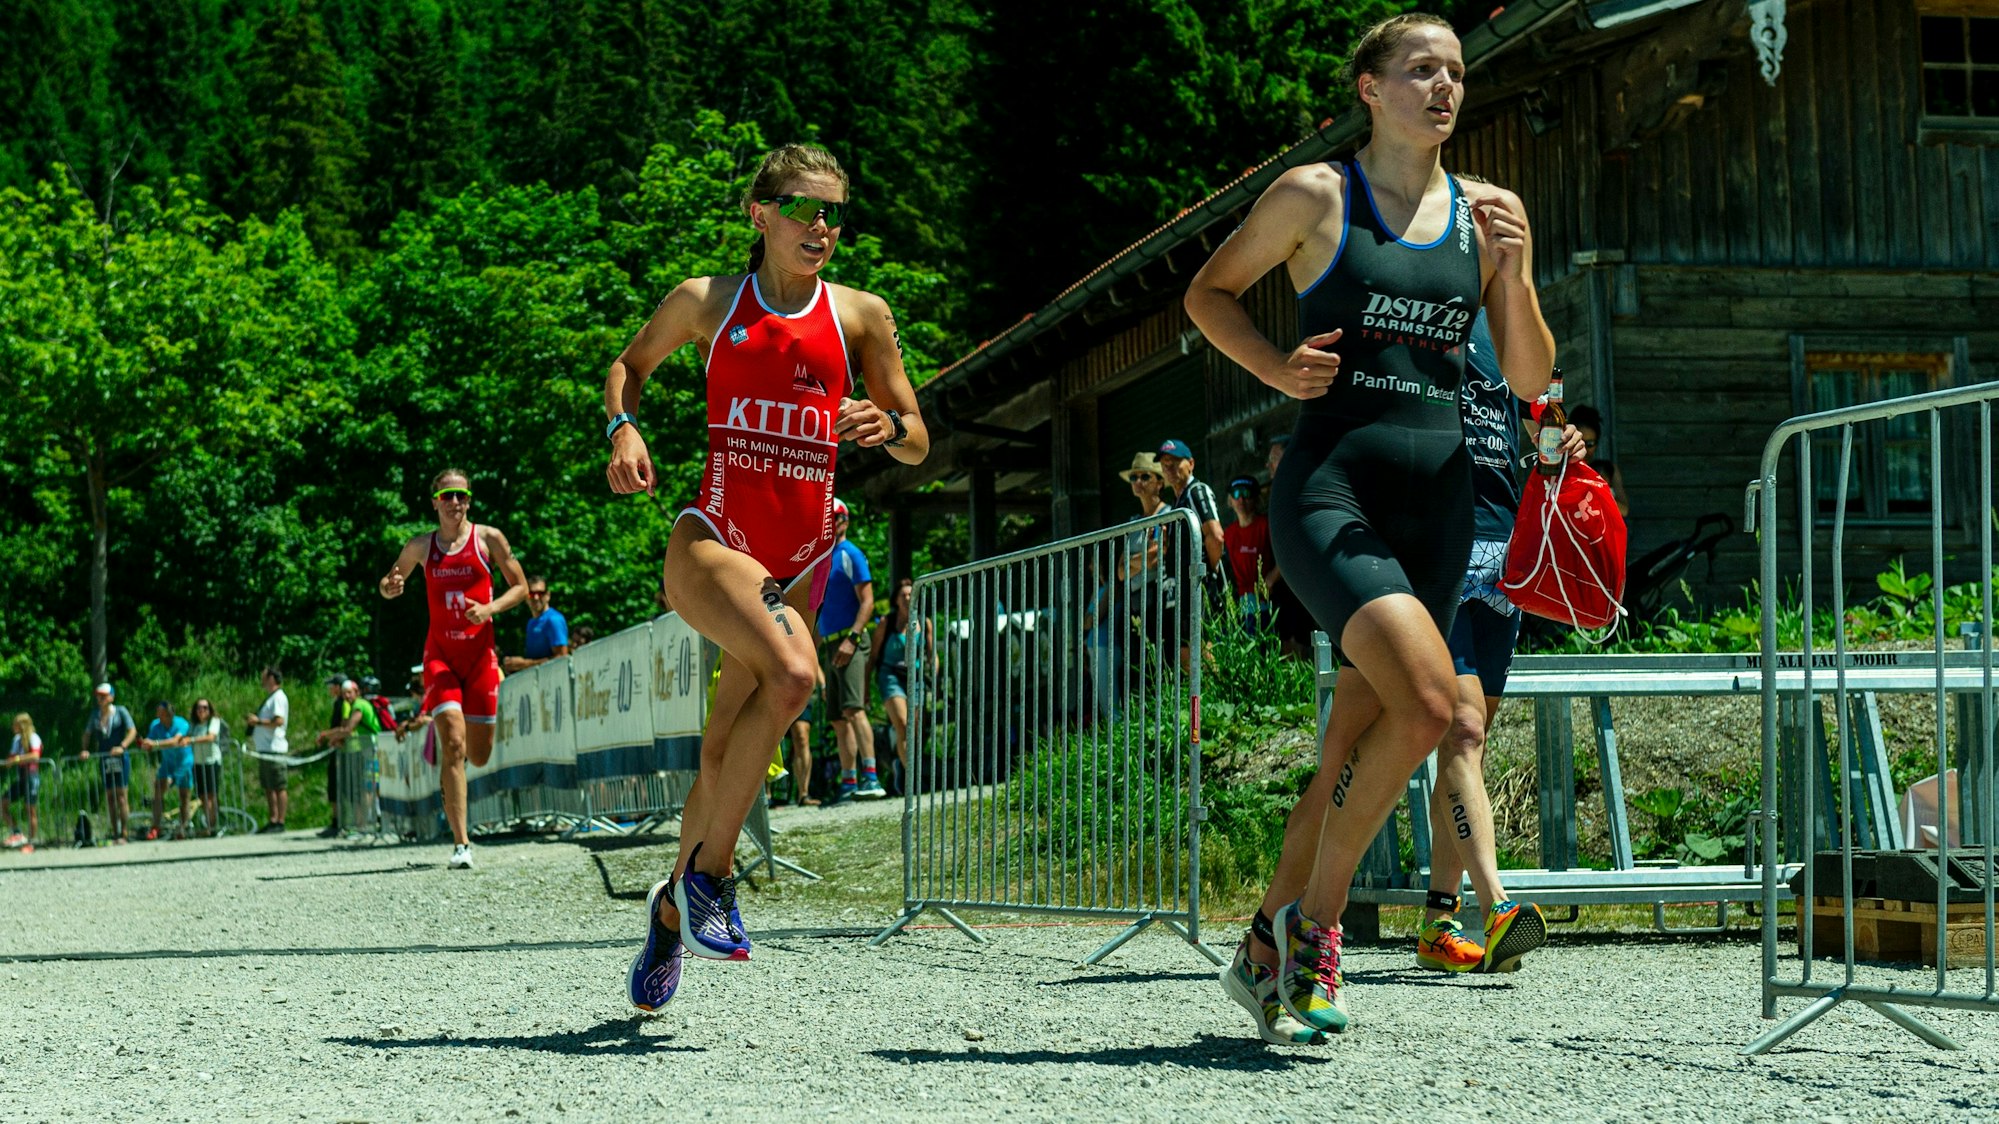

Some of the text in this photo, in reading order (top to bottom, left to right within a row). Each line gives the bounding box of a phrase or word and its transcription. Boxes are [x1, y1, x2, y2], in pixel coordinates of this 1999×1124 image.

[1455, 197, 1472, 254] sailfish
[1363, 315, 1462, 342] DARMSTADT
[1353, 371, 1421, 394] PanTum
[1471, 404, 1507, 422] BONN
[727, 437, 829, 464] IHR MINI PARTNER
[727, 451, 827, 482] ROLF HORN
[431, 566, 474, 578] ERDINGER
[1853, 653, 1898, 666] MOHR
[1452, 804, 1472, 840] 29
